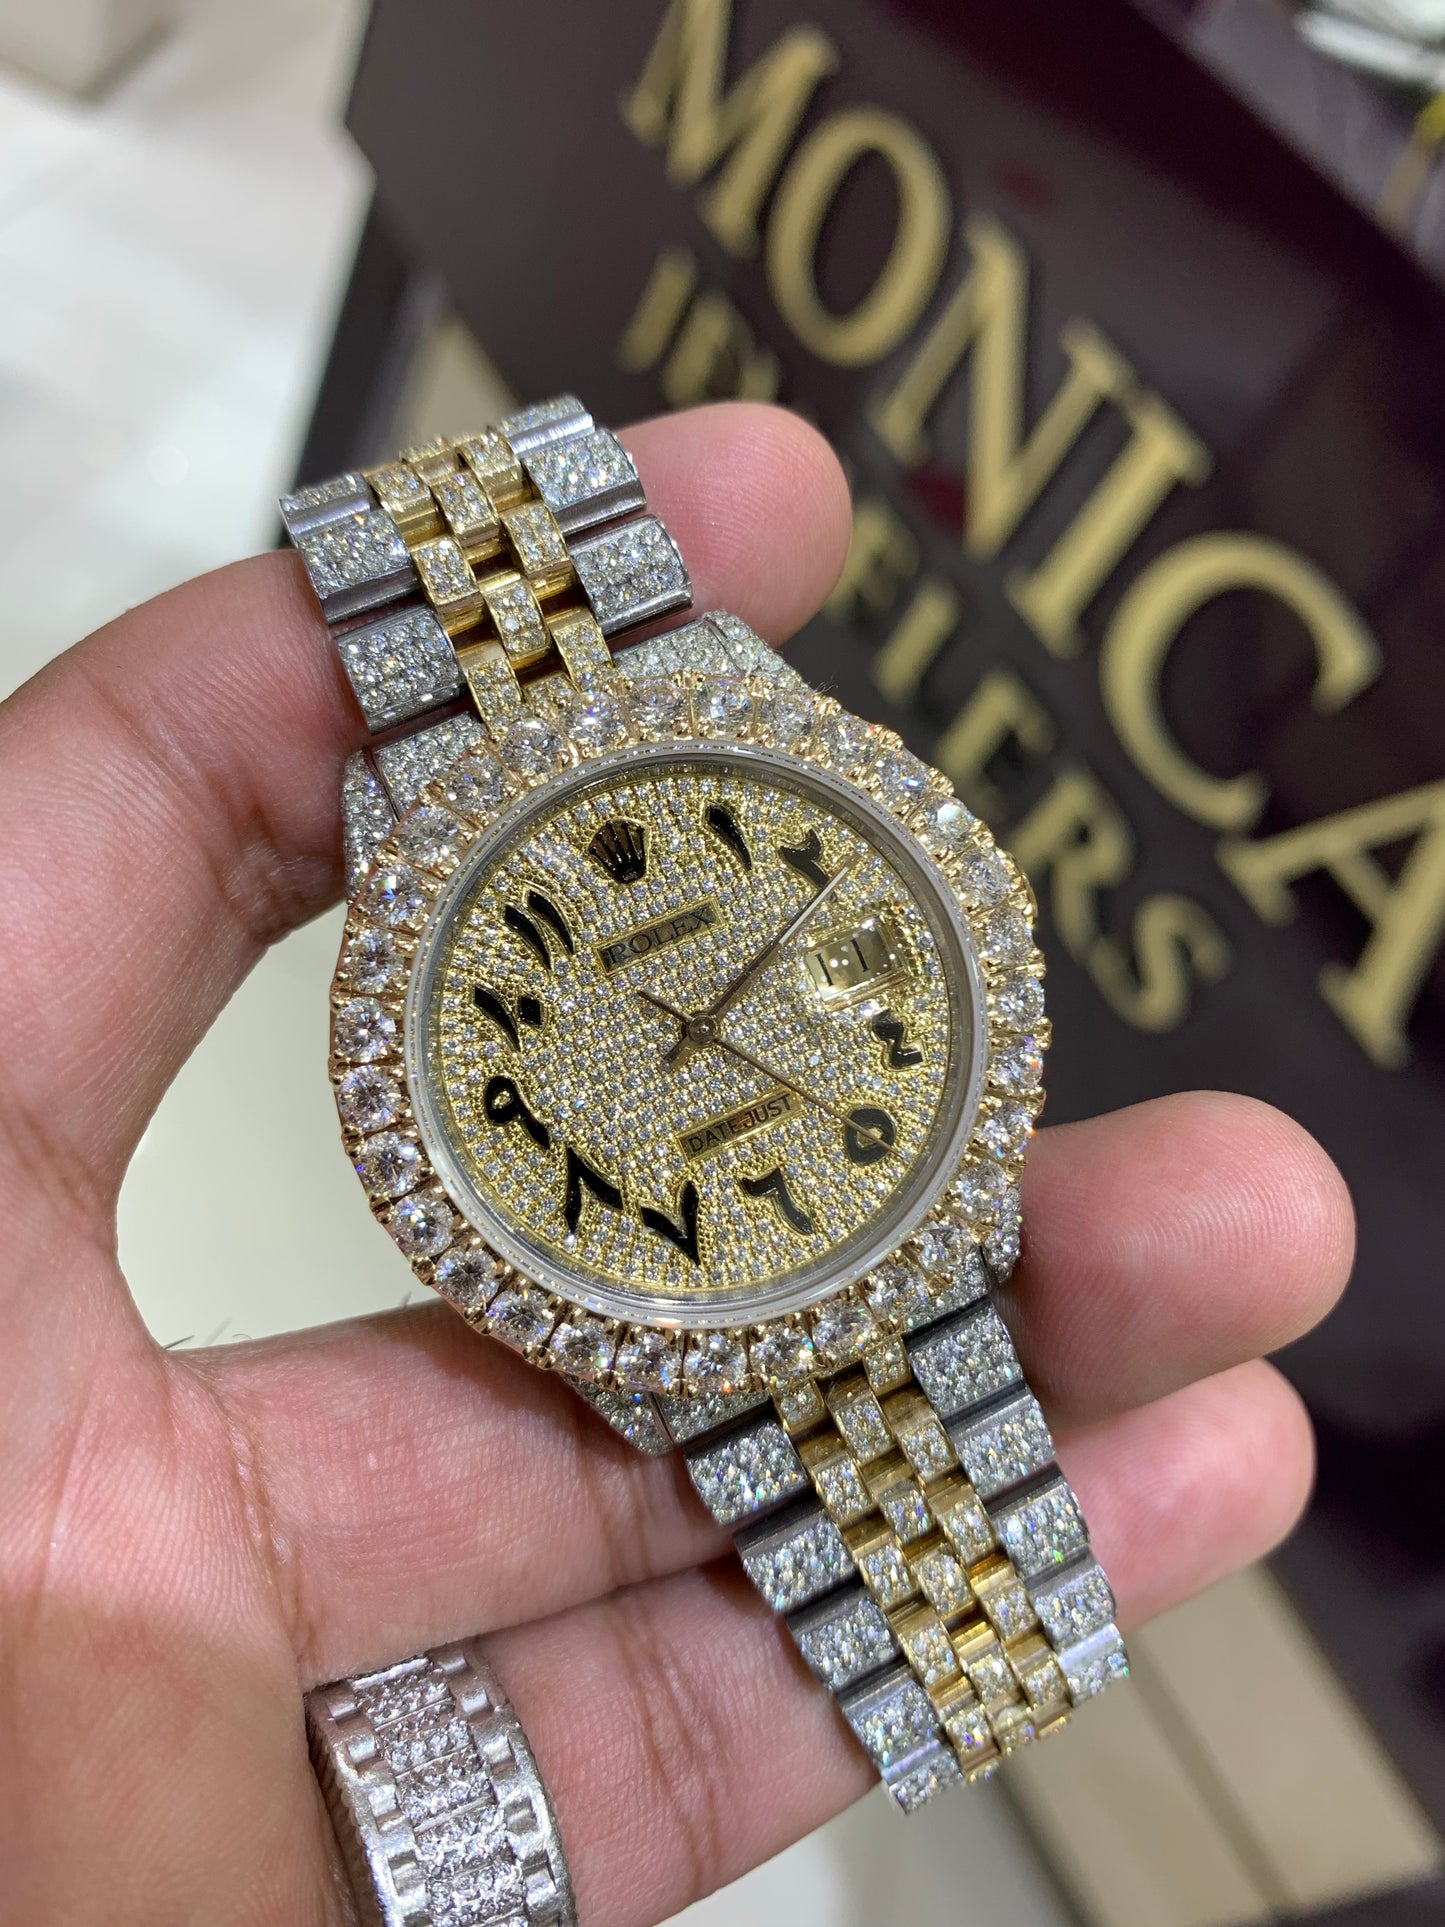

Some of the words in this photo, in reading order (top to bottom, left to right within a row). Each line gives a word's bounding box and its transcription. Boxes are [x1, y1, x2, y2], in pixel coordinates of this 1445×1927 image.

[621, 0, 1445, 1066] MONICA
[604, 906, 713, 965] ROLEX
[687, 1092, 792, 1153] DATEJUST
